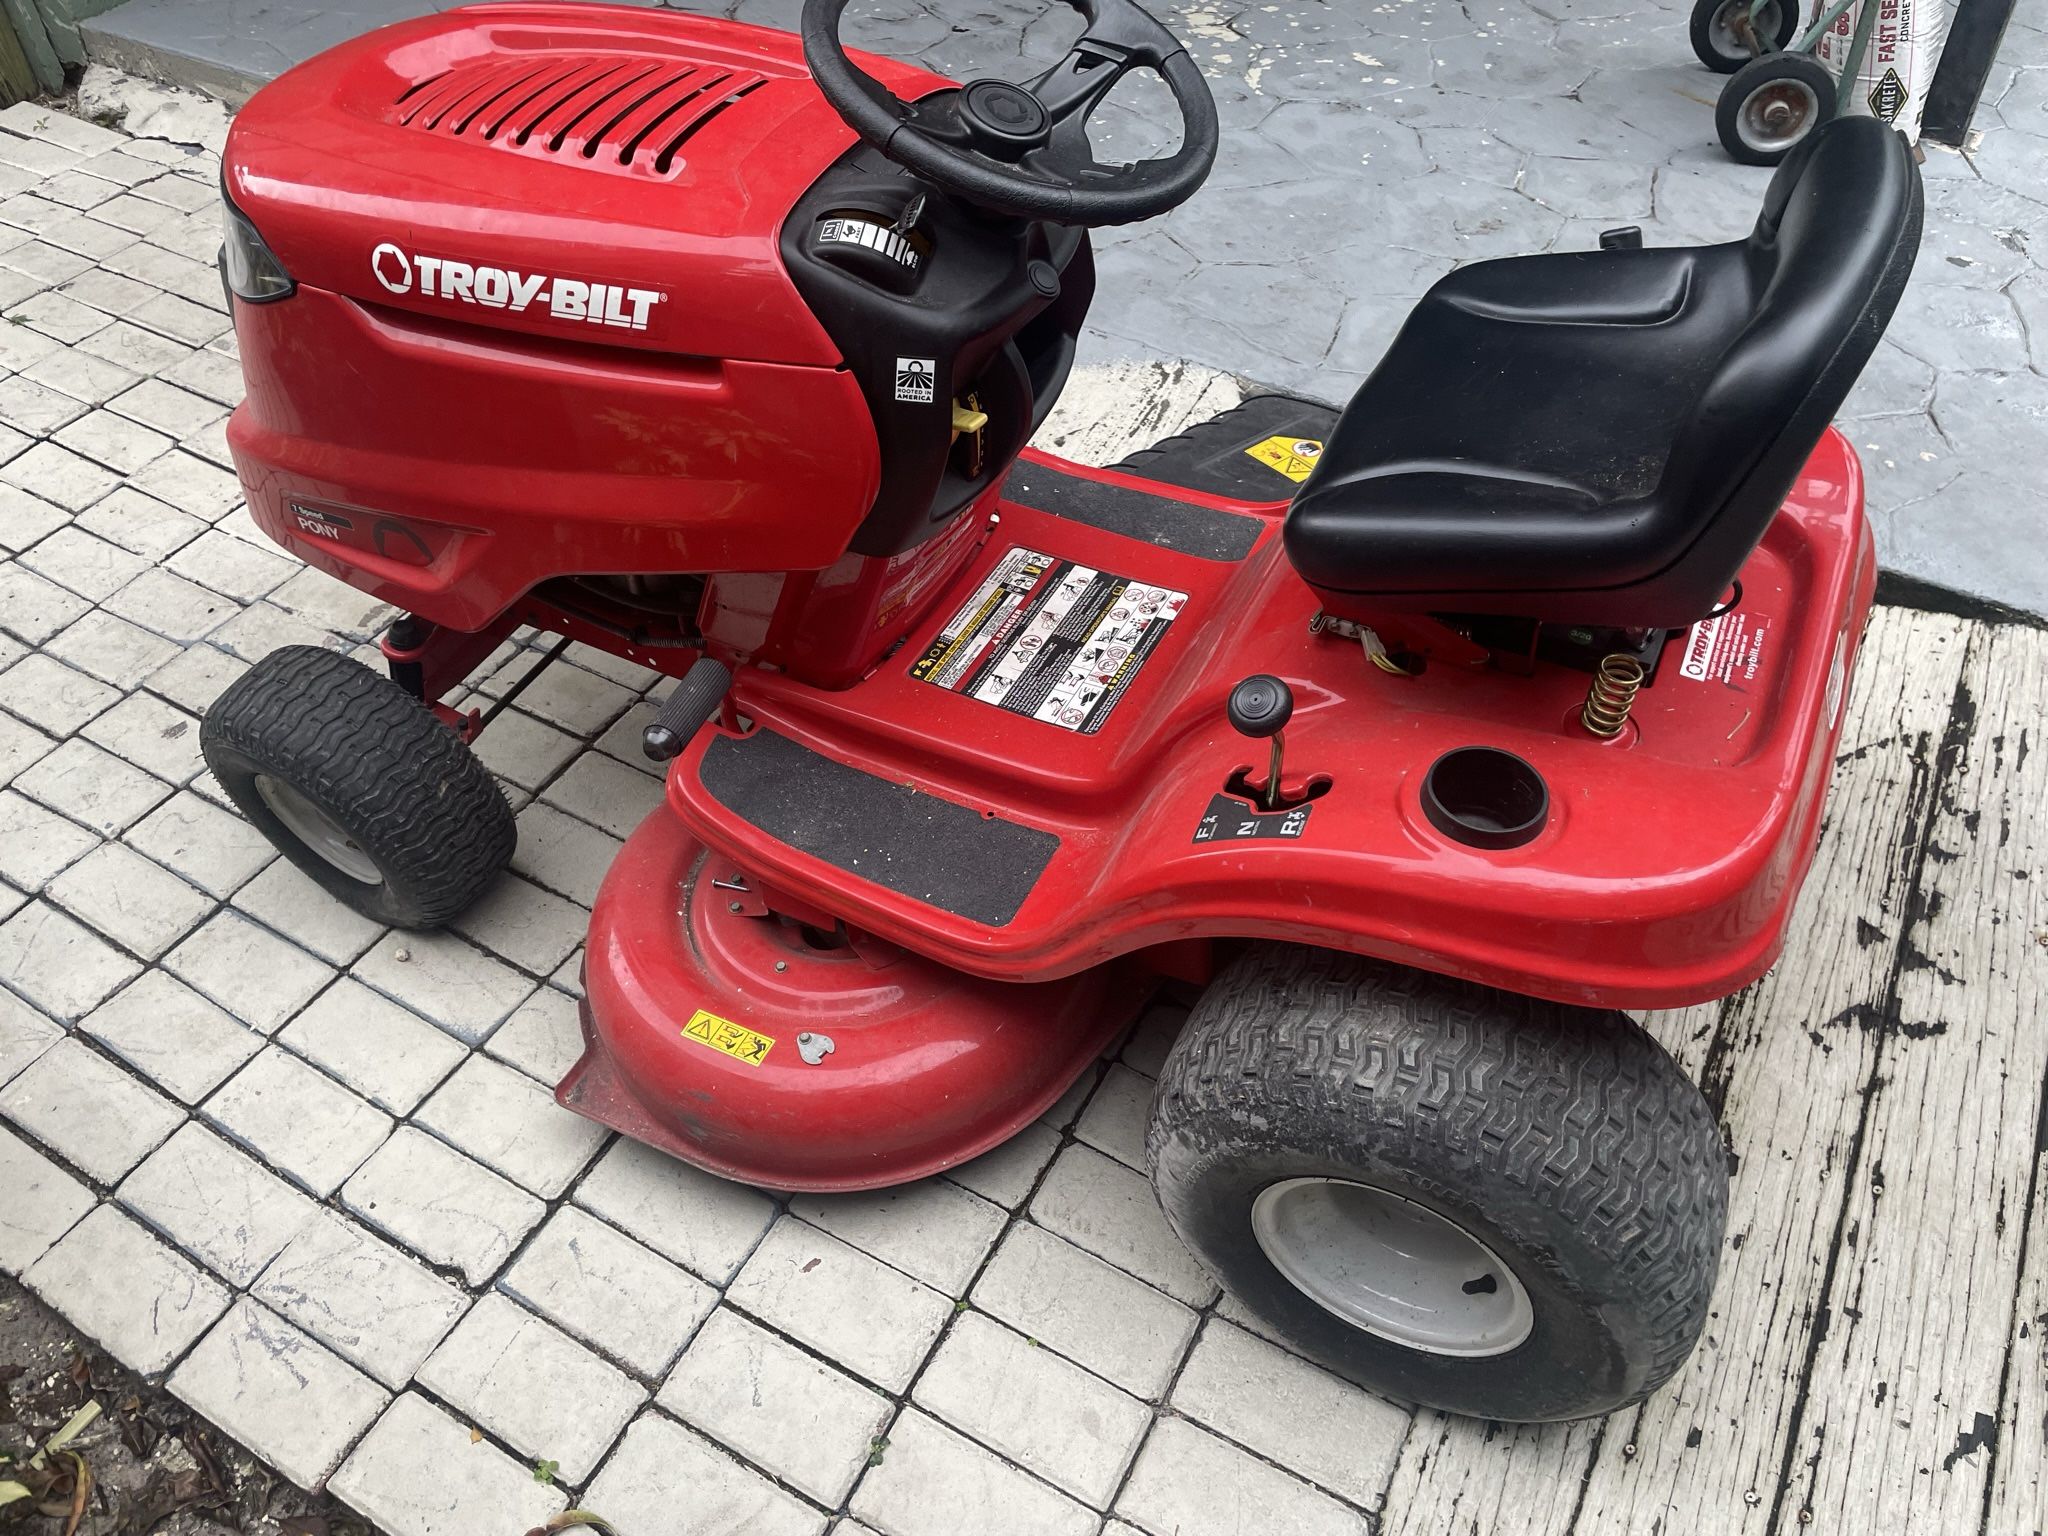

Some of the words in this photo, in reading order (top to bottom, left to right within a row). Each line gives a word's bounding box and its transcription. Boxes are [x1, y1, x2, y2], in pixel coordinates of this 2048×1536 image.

[1900, 0, 1910, 41] CONCRE
[1877, 23, 1897, 62] FAST
[1880, 77, 1897, 123] SAKRETE
[413, 254, 660, 330] TROY-BILT
[896, 393, 931, 401] AMERICA
[297, 516, 340, 540] PONY
[994, 608, 1023, 638] DANGER
[1111, 653, 1136, 684] WARNING
[1744, 628, 1765, 680] troybilt.com
[1196, 827, 1210, 839] F
[1237, 821, 1255, 836] N
[1280, 820, 1300, 835] R
